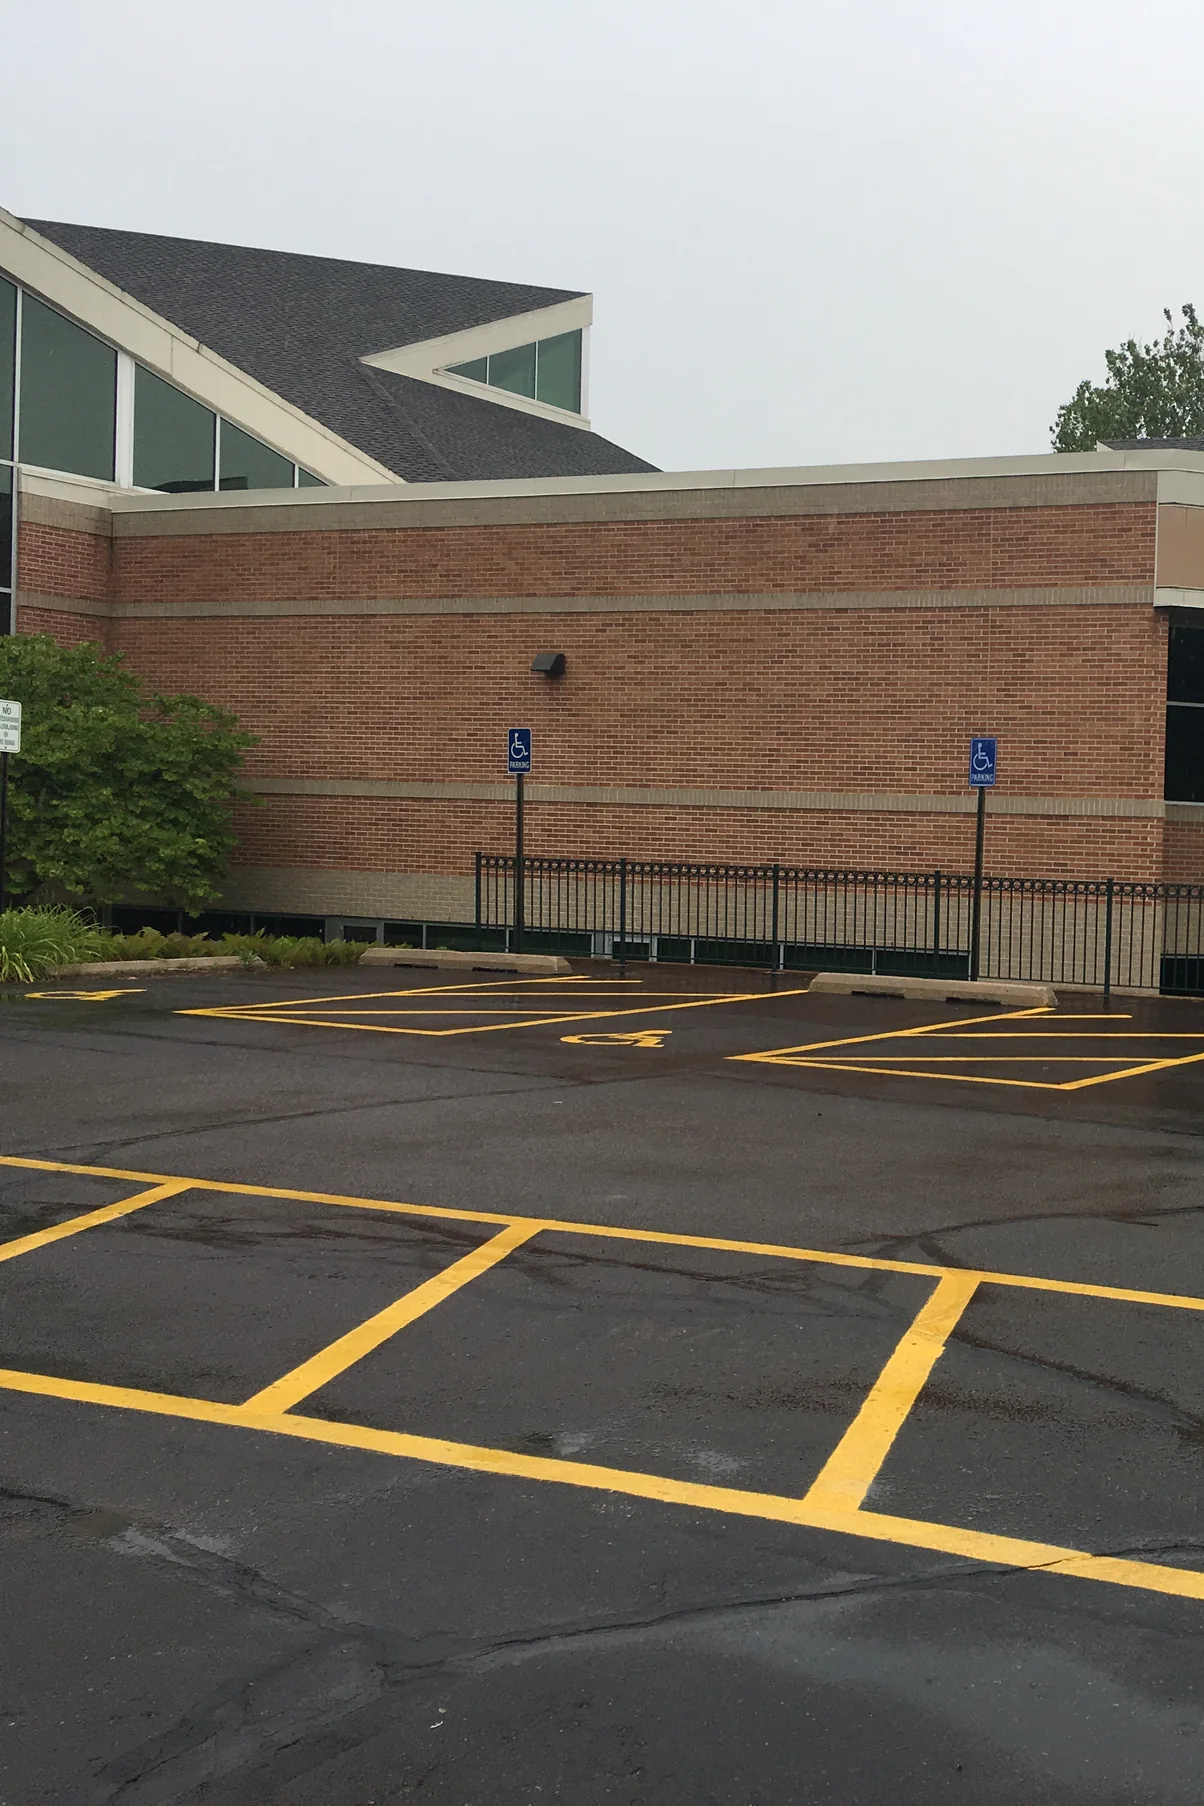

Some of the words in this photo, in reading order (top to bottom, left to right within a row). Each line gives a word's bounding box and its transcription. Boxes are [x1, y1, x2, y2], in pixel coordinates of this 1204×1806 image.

[2, 707, 12, 715] NO
[510, 761, 529, 769] PARKING
[971, 773, 993, 782] PARKING
